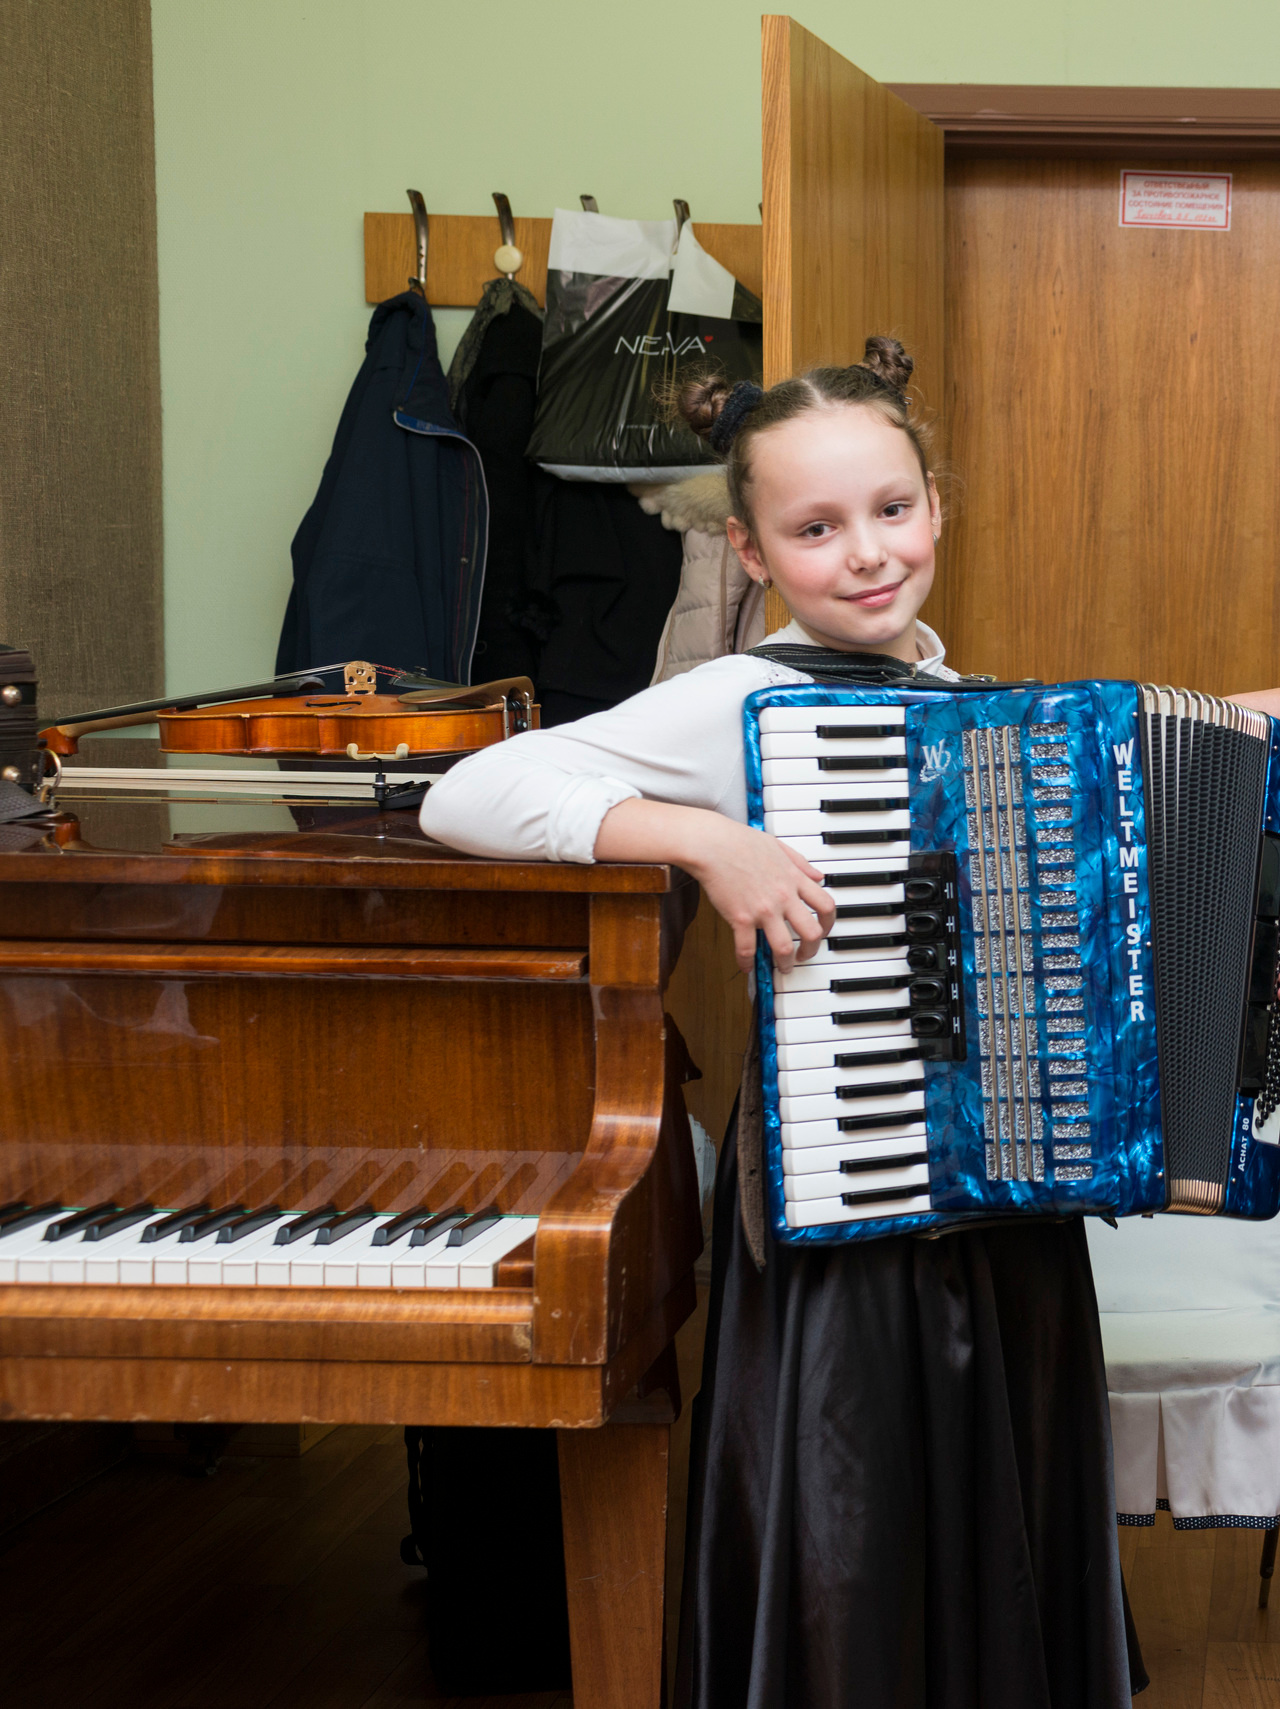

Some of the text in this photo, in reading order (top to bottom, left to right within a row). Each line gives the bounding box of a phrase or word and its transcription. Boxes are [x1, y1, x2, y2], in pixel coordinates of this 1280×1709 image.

[1144, 180, 1209, 189] ОТВЕТСТВЕННЫЙ
[1132, 190, 1220, 200] ЗА ПРОТИВОПОЖАРНОЕ
[1128, 200, 1173, 208] СОСТОЯНИЕ
[1112, 737, 1146, 1022] WELTMEISTER
[1241, 1117, 1250, 1131] 80
